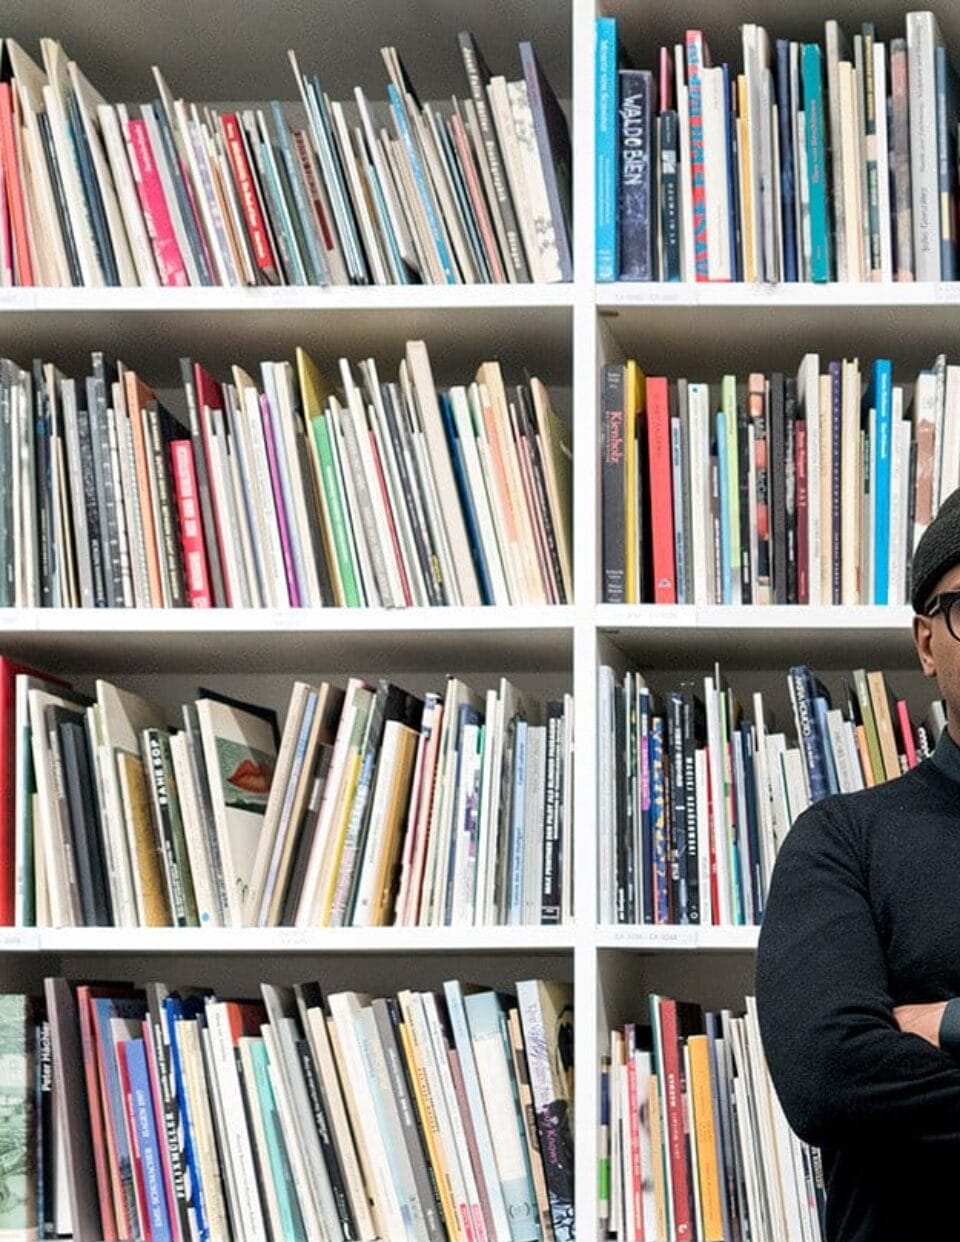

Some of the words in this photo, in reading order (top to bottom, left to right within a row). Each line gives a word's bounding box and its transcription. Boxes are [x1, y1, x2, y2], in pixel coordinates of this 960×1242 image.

[623, 94, 644, 146] WALDO
[623, 150, 644, 185] BIEN
[610, 411, 623, 464] Kienholz
[42, 1057, 52, 1091] Peter
[142, 1147, 159, 1204] SCHUMACHER
